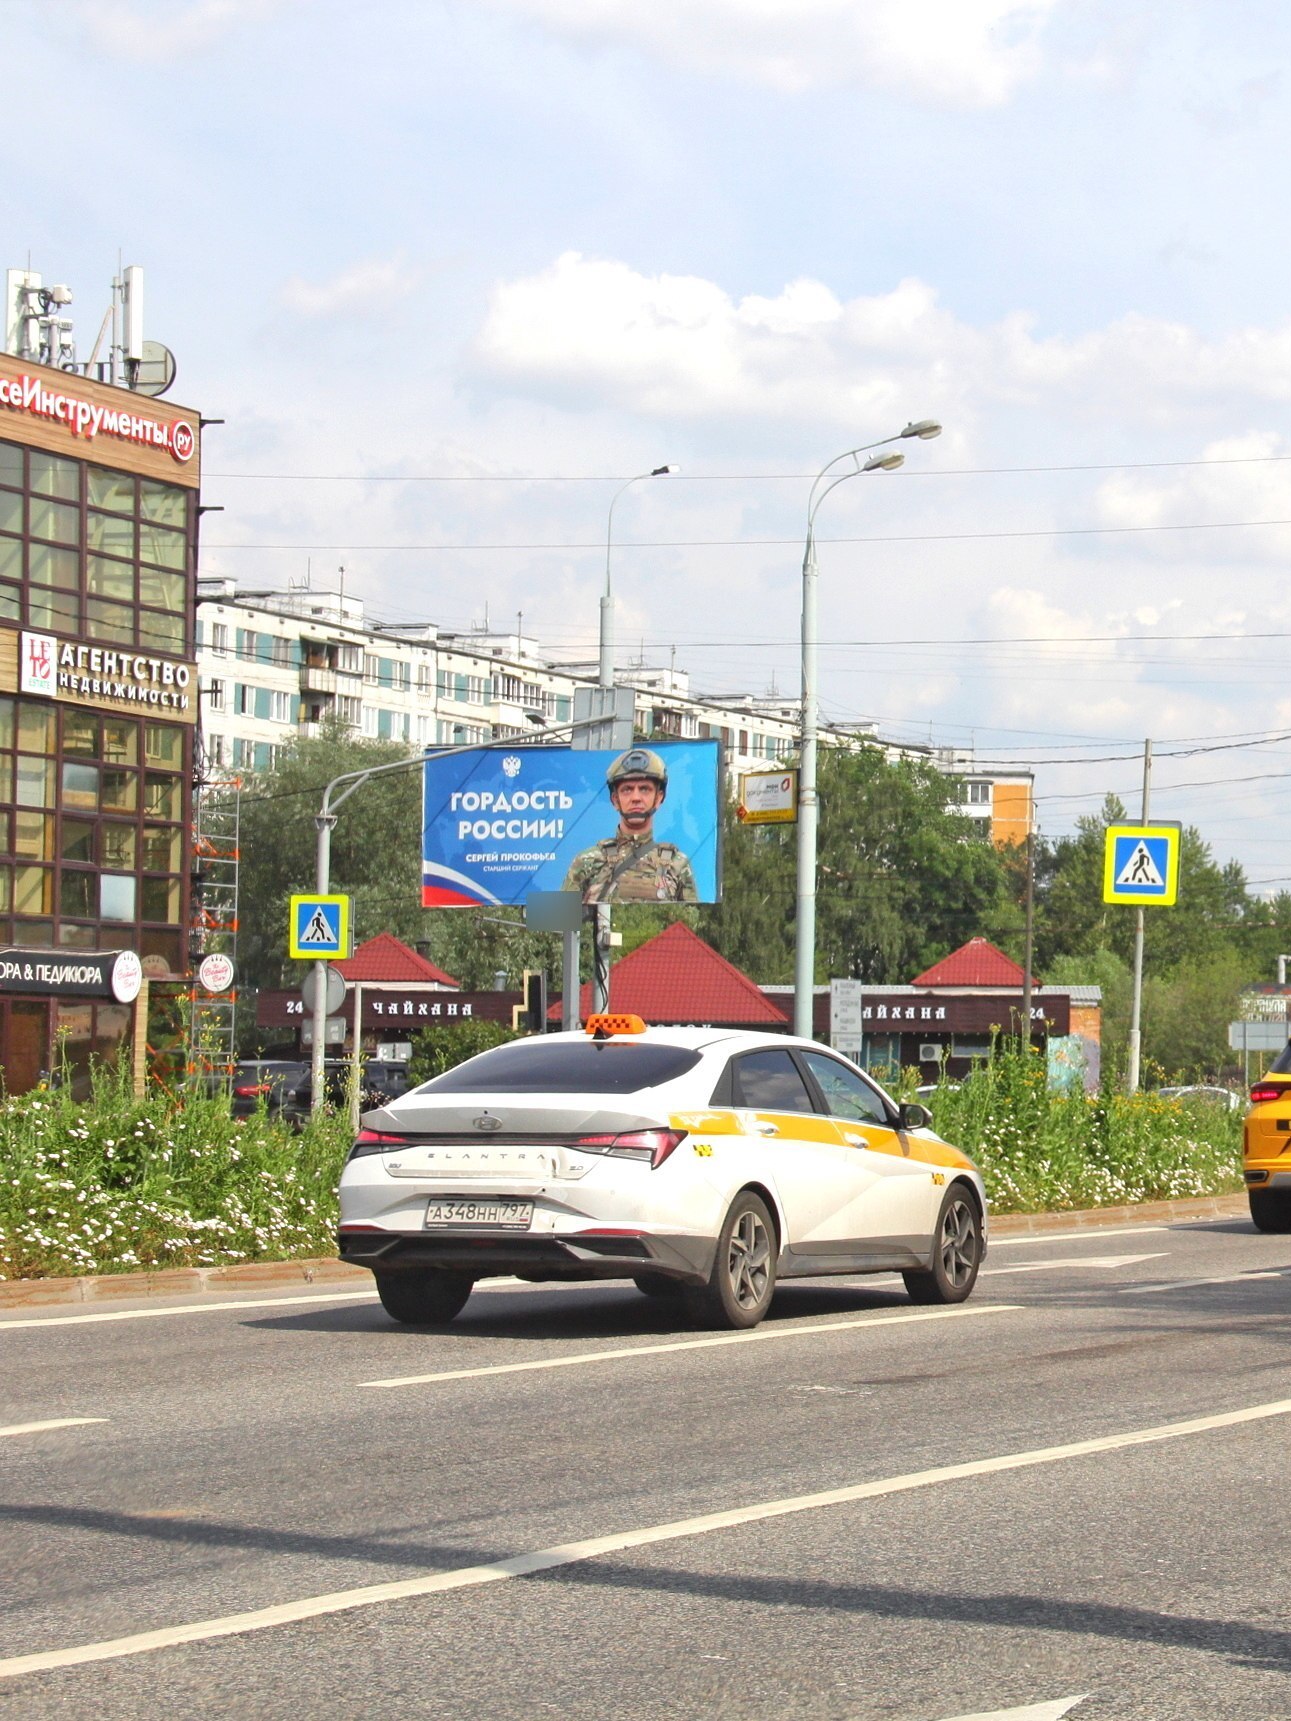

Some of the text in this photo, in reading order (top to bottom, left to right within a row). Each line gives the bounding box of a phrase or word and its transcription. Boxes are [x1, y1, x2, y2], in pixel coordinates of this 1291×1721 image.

[60, 643, 190, 688] АГЕНТСТВО
[28, 677, 51, 690] ESTATE
[59, 672, 189, 709] НЕДВИЖИМОСТИ
[451, 791, 573, 814] ГОРДОСТЬ
[458, 819, 564, 840] РОССИИ!
[465, 851, 556, 862] СЕРГЕЙ ПРОКОФЬЕВ
[483, 864, 511, 872] СТАРШИЙ
[24, 963, 34, 981] &
[36, 964, 103, 985] ПЕДИКЮРА
[286, 1001, 472, 1016] 24 ЧАЙХАНА
[1029, 1007, 1045, 1019] 24
[502, 1202, 526, 1217] 797
